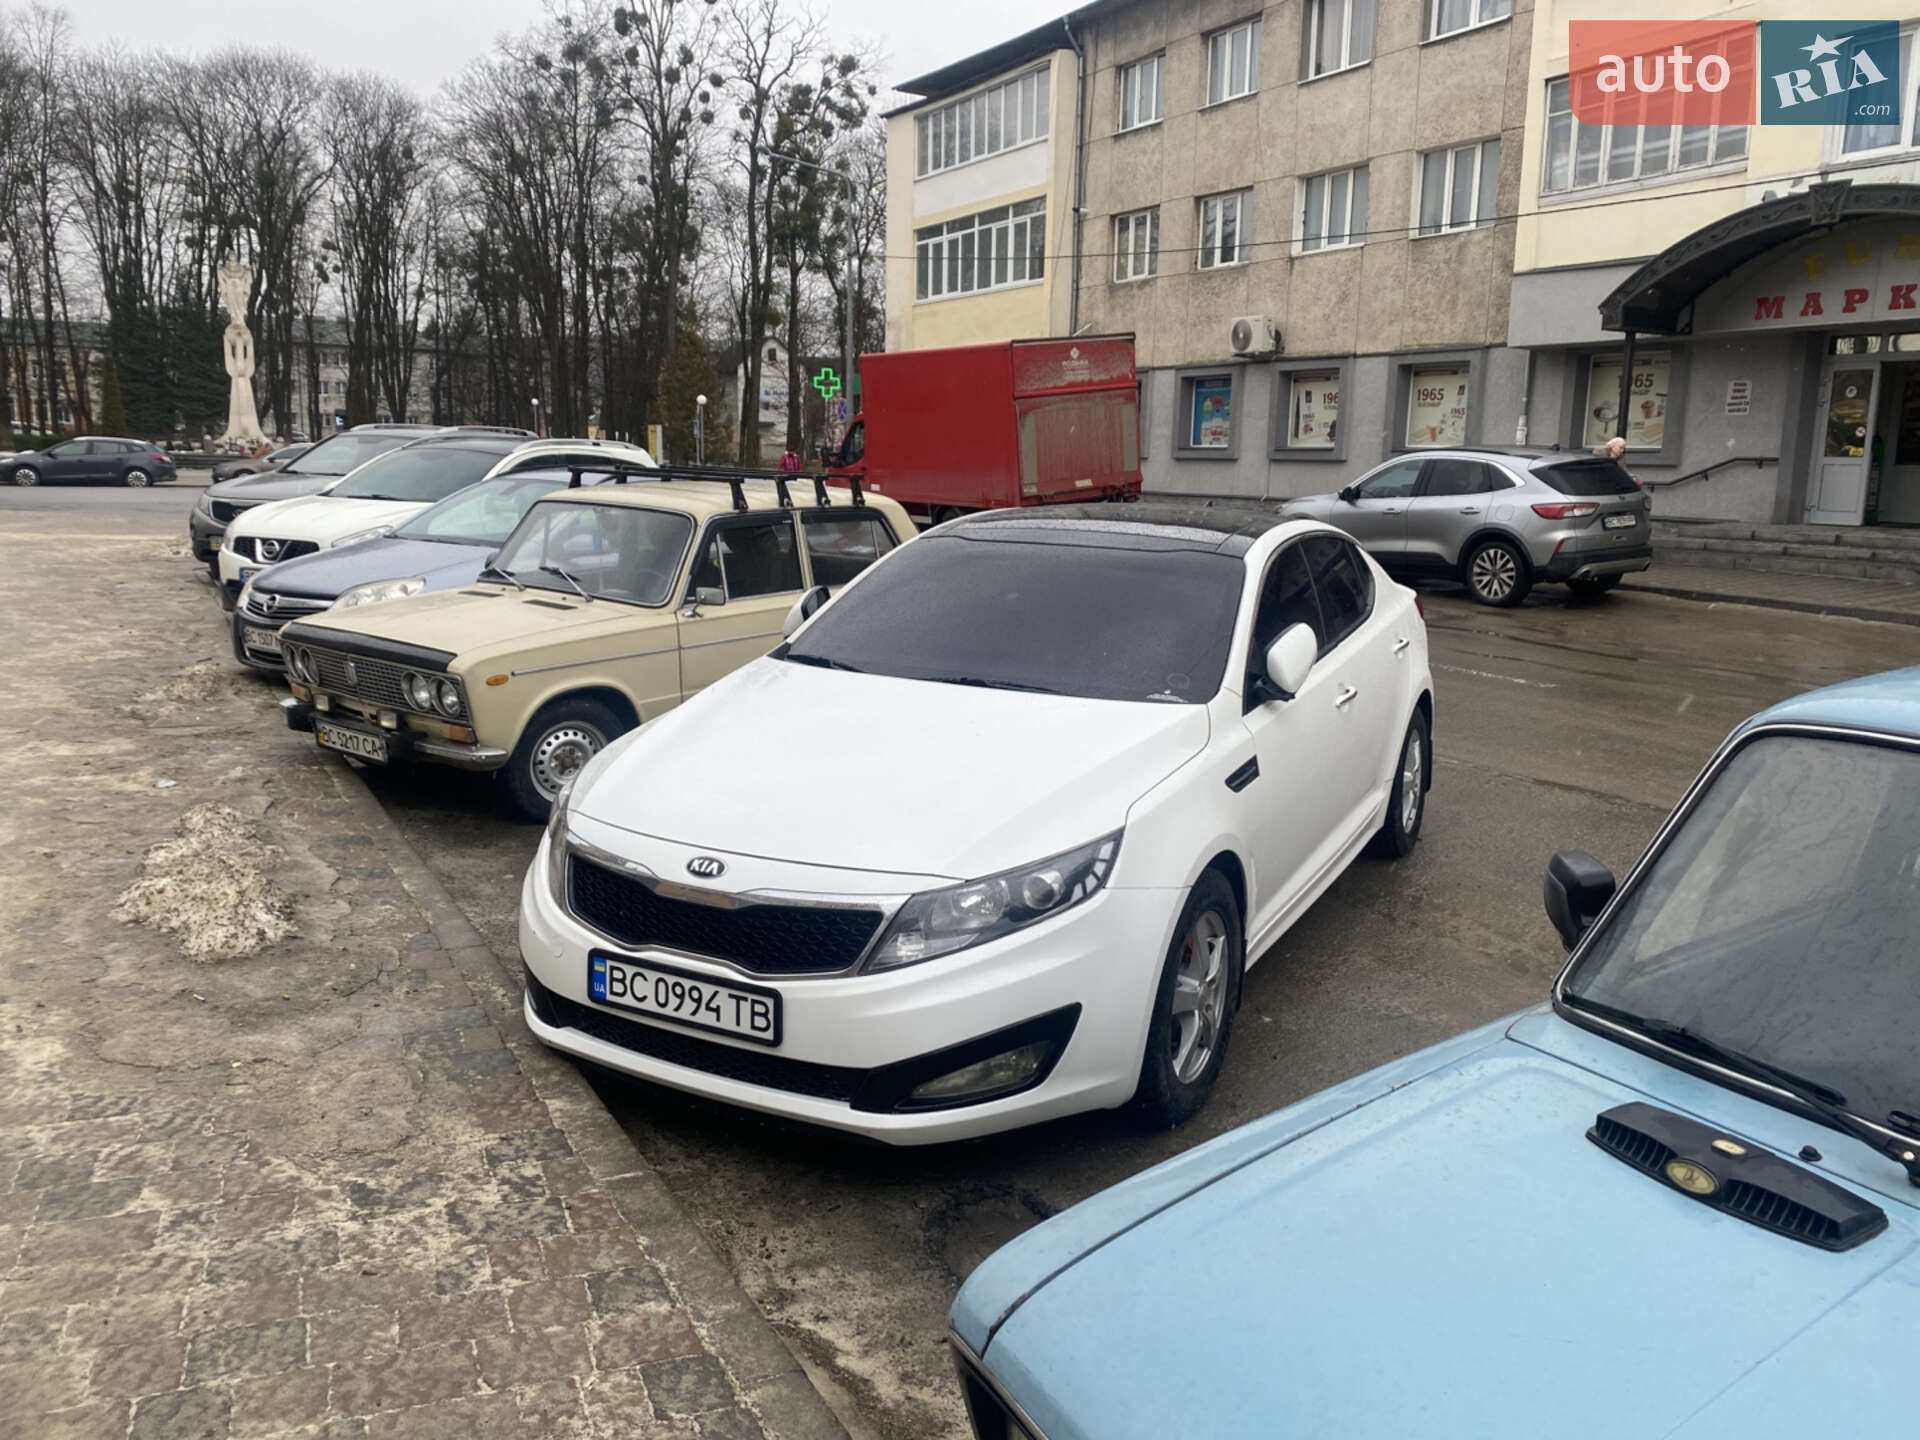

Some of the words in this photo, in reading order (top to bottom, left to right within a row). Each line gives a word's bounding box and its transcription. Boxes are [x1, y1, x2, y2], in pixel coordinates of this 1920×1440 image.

[1416, 387, 1446, 401] 1965
[689, 858, 719, 876] KIA
[593, 982, 606, 993] UA
